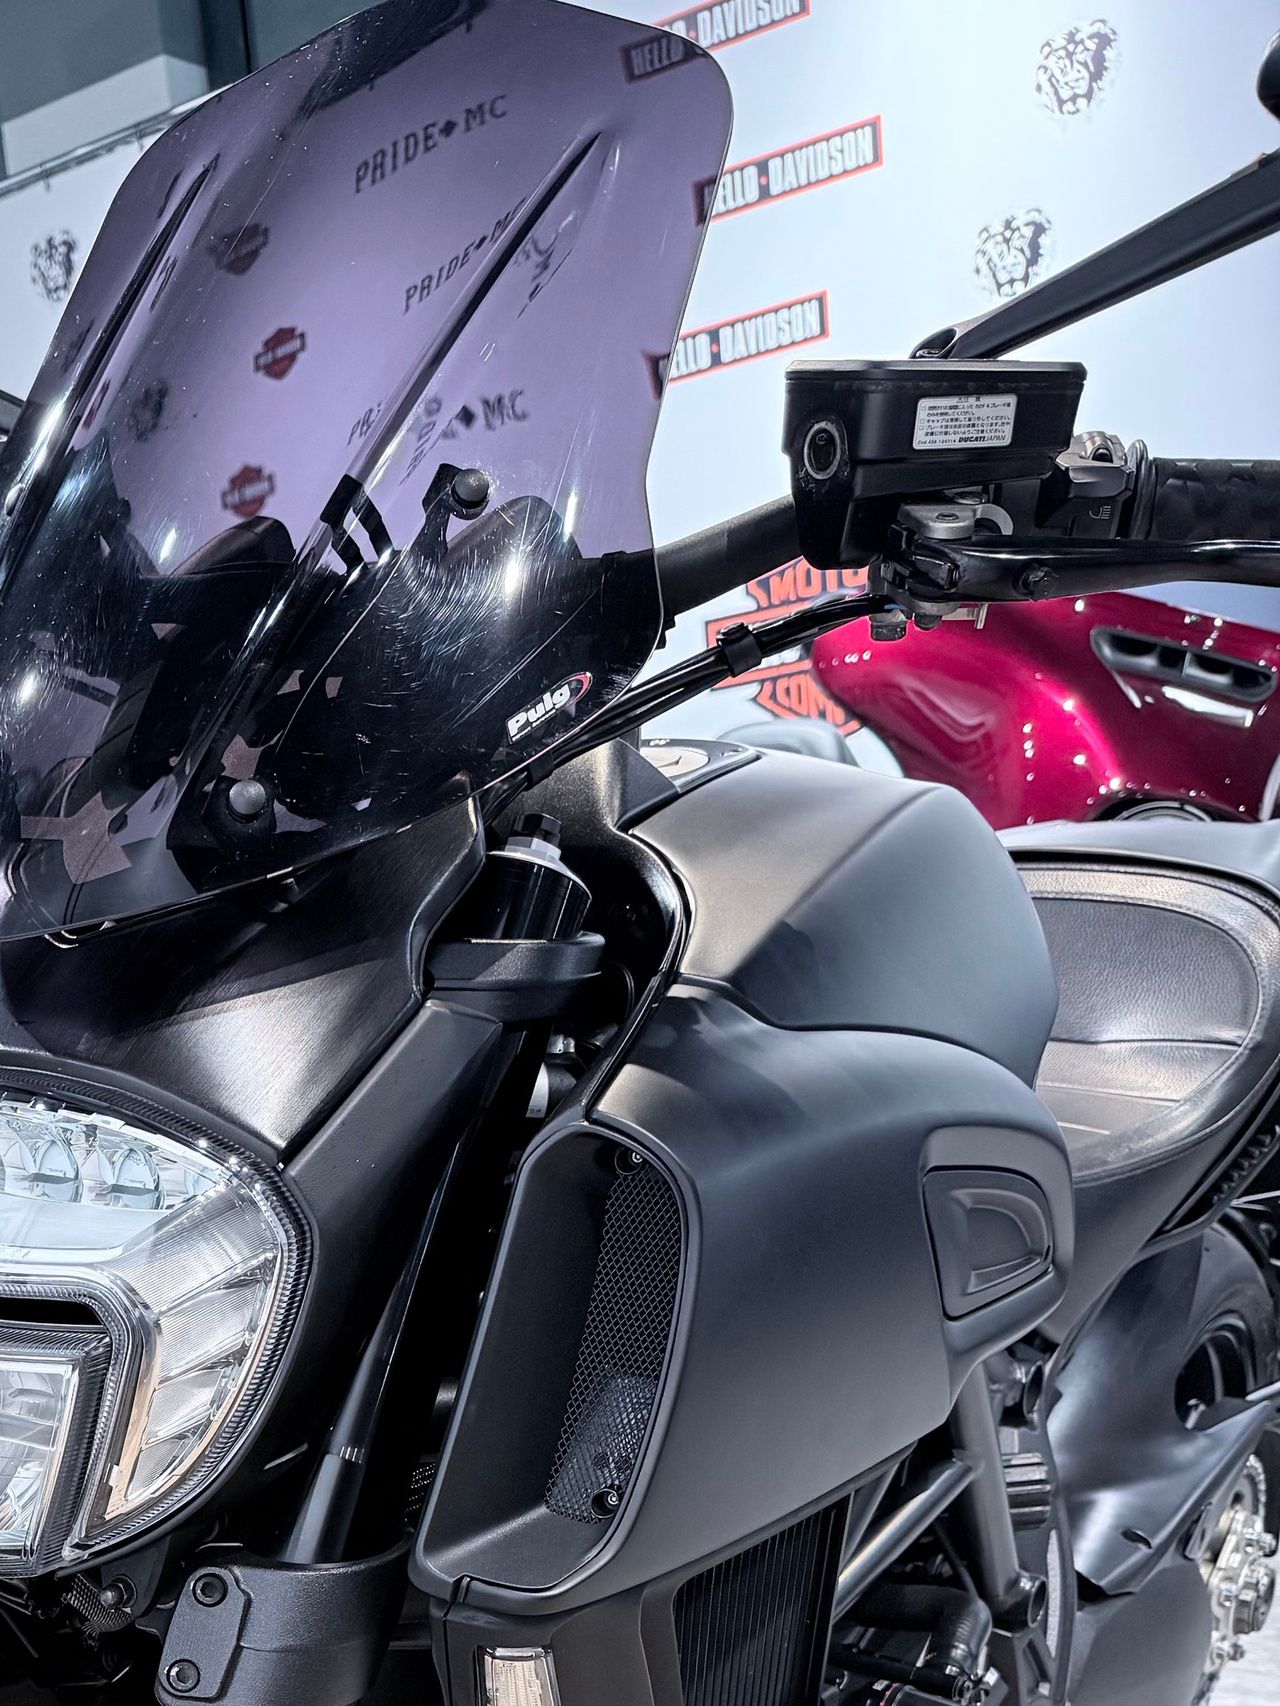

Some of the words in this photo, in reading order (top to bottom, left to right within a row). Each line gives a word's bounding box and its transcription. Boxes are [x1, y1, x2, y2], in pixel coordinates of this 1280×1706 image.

[354, 120, 438, 194] PRIDE
[463, 94, 507, 133] MC
[767, 125, 874, 196] DAVIDSON
[403, 240, 476, 315] PRIDE
[719, 298, 821, 364] DAVIDSON
